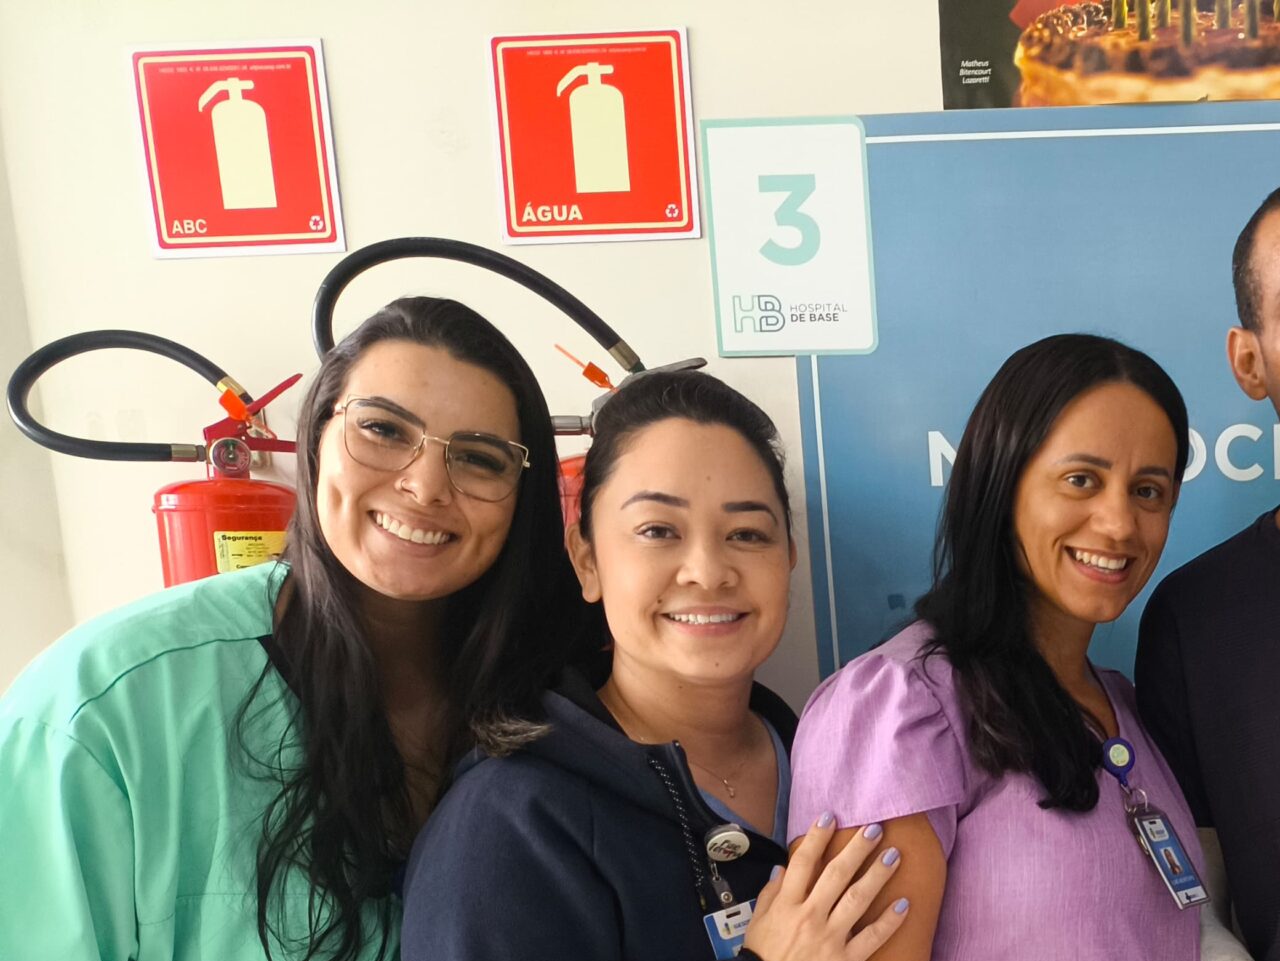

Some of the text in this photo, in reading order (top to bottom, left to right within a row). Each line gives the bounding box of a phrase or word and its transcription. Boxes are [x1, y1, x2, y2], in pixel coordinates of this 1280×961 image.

[521, 202, 583, 222] ÁGUA
[758, 173, 821, 267] 3
[172, 218, 208, 234] ABC
[790, 303, 848, 313] HOSPITAL
[790, 312, 840, 322] DE BASE
